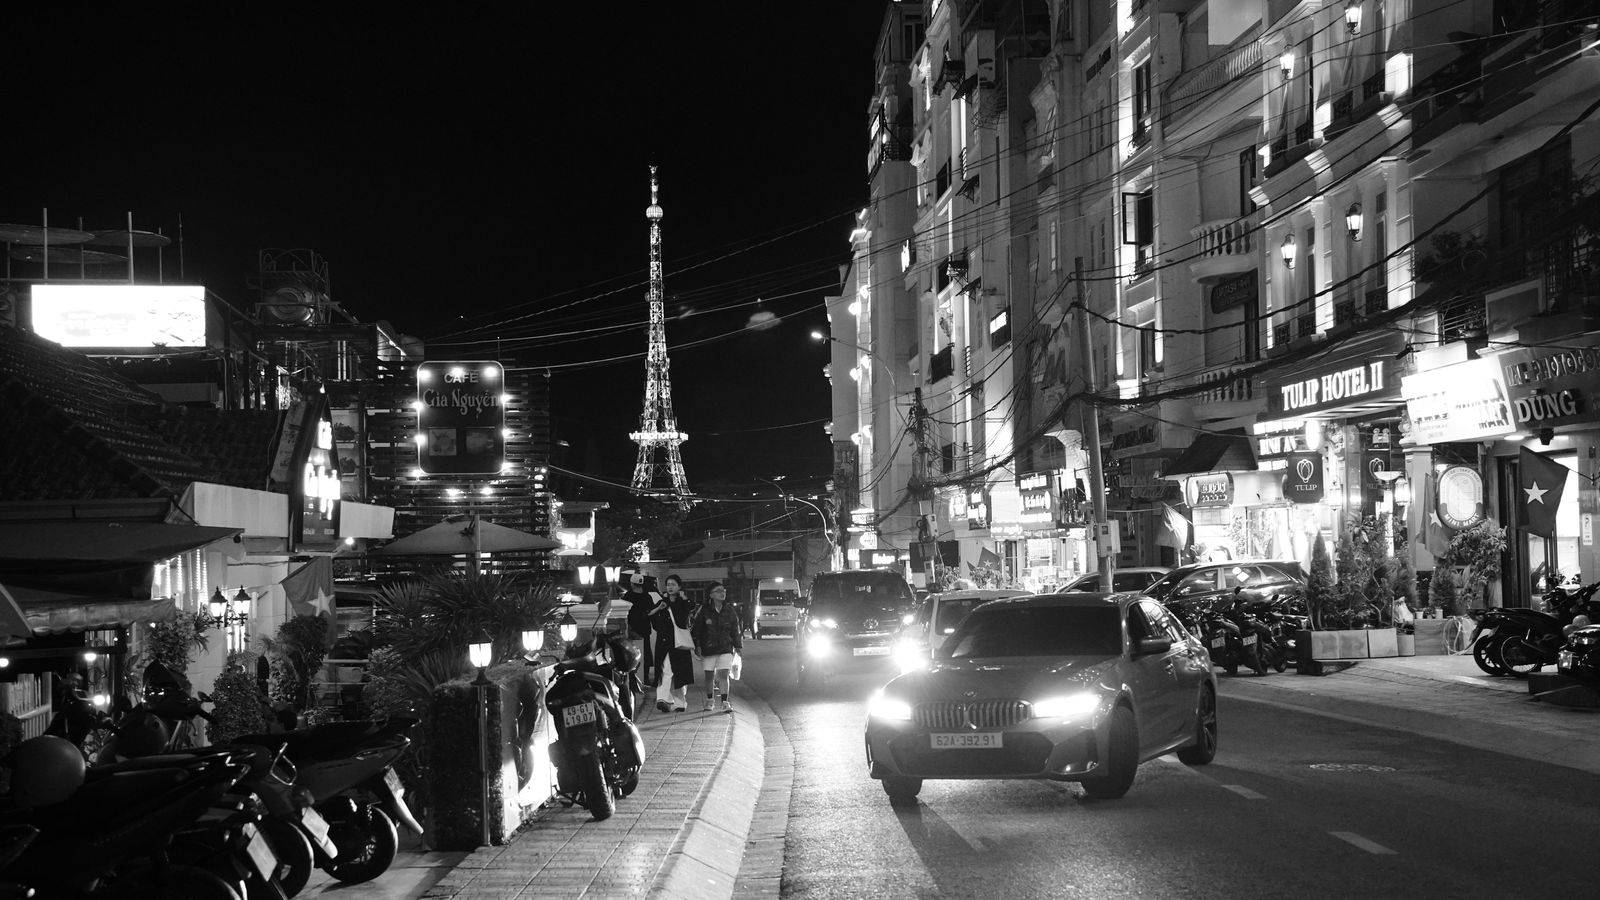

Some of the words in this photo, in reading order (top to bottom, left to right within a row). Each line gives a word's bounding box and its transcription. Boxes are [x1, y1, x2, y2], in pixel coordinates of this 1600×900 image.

[1282, 378, 1319, 411] TULIP
[1321, 366, 1370, 402] HOTEL
[1370, 361, 1384, 391] II
[423, 388, 448, 407] Gia
[1444, 513, 1460, 527] MINI
[1462, 512, 1479, 527] MART
